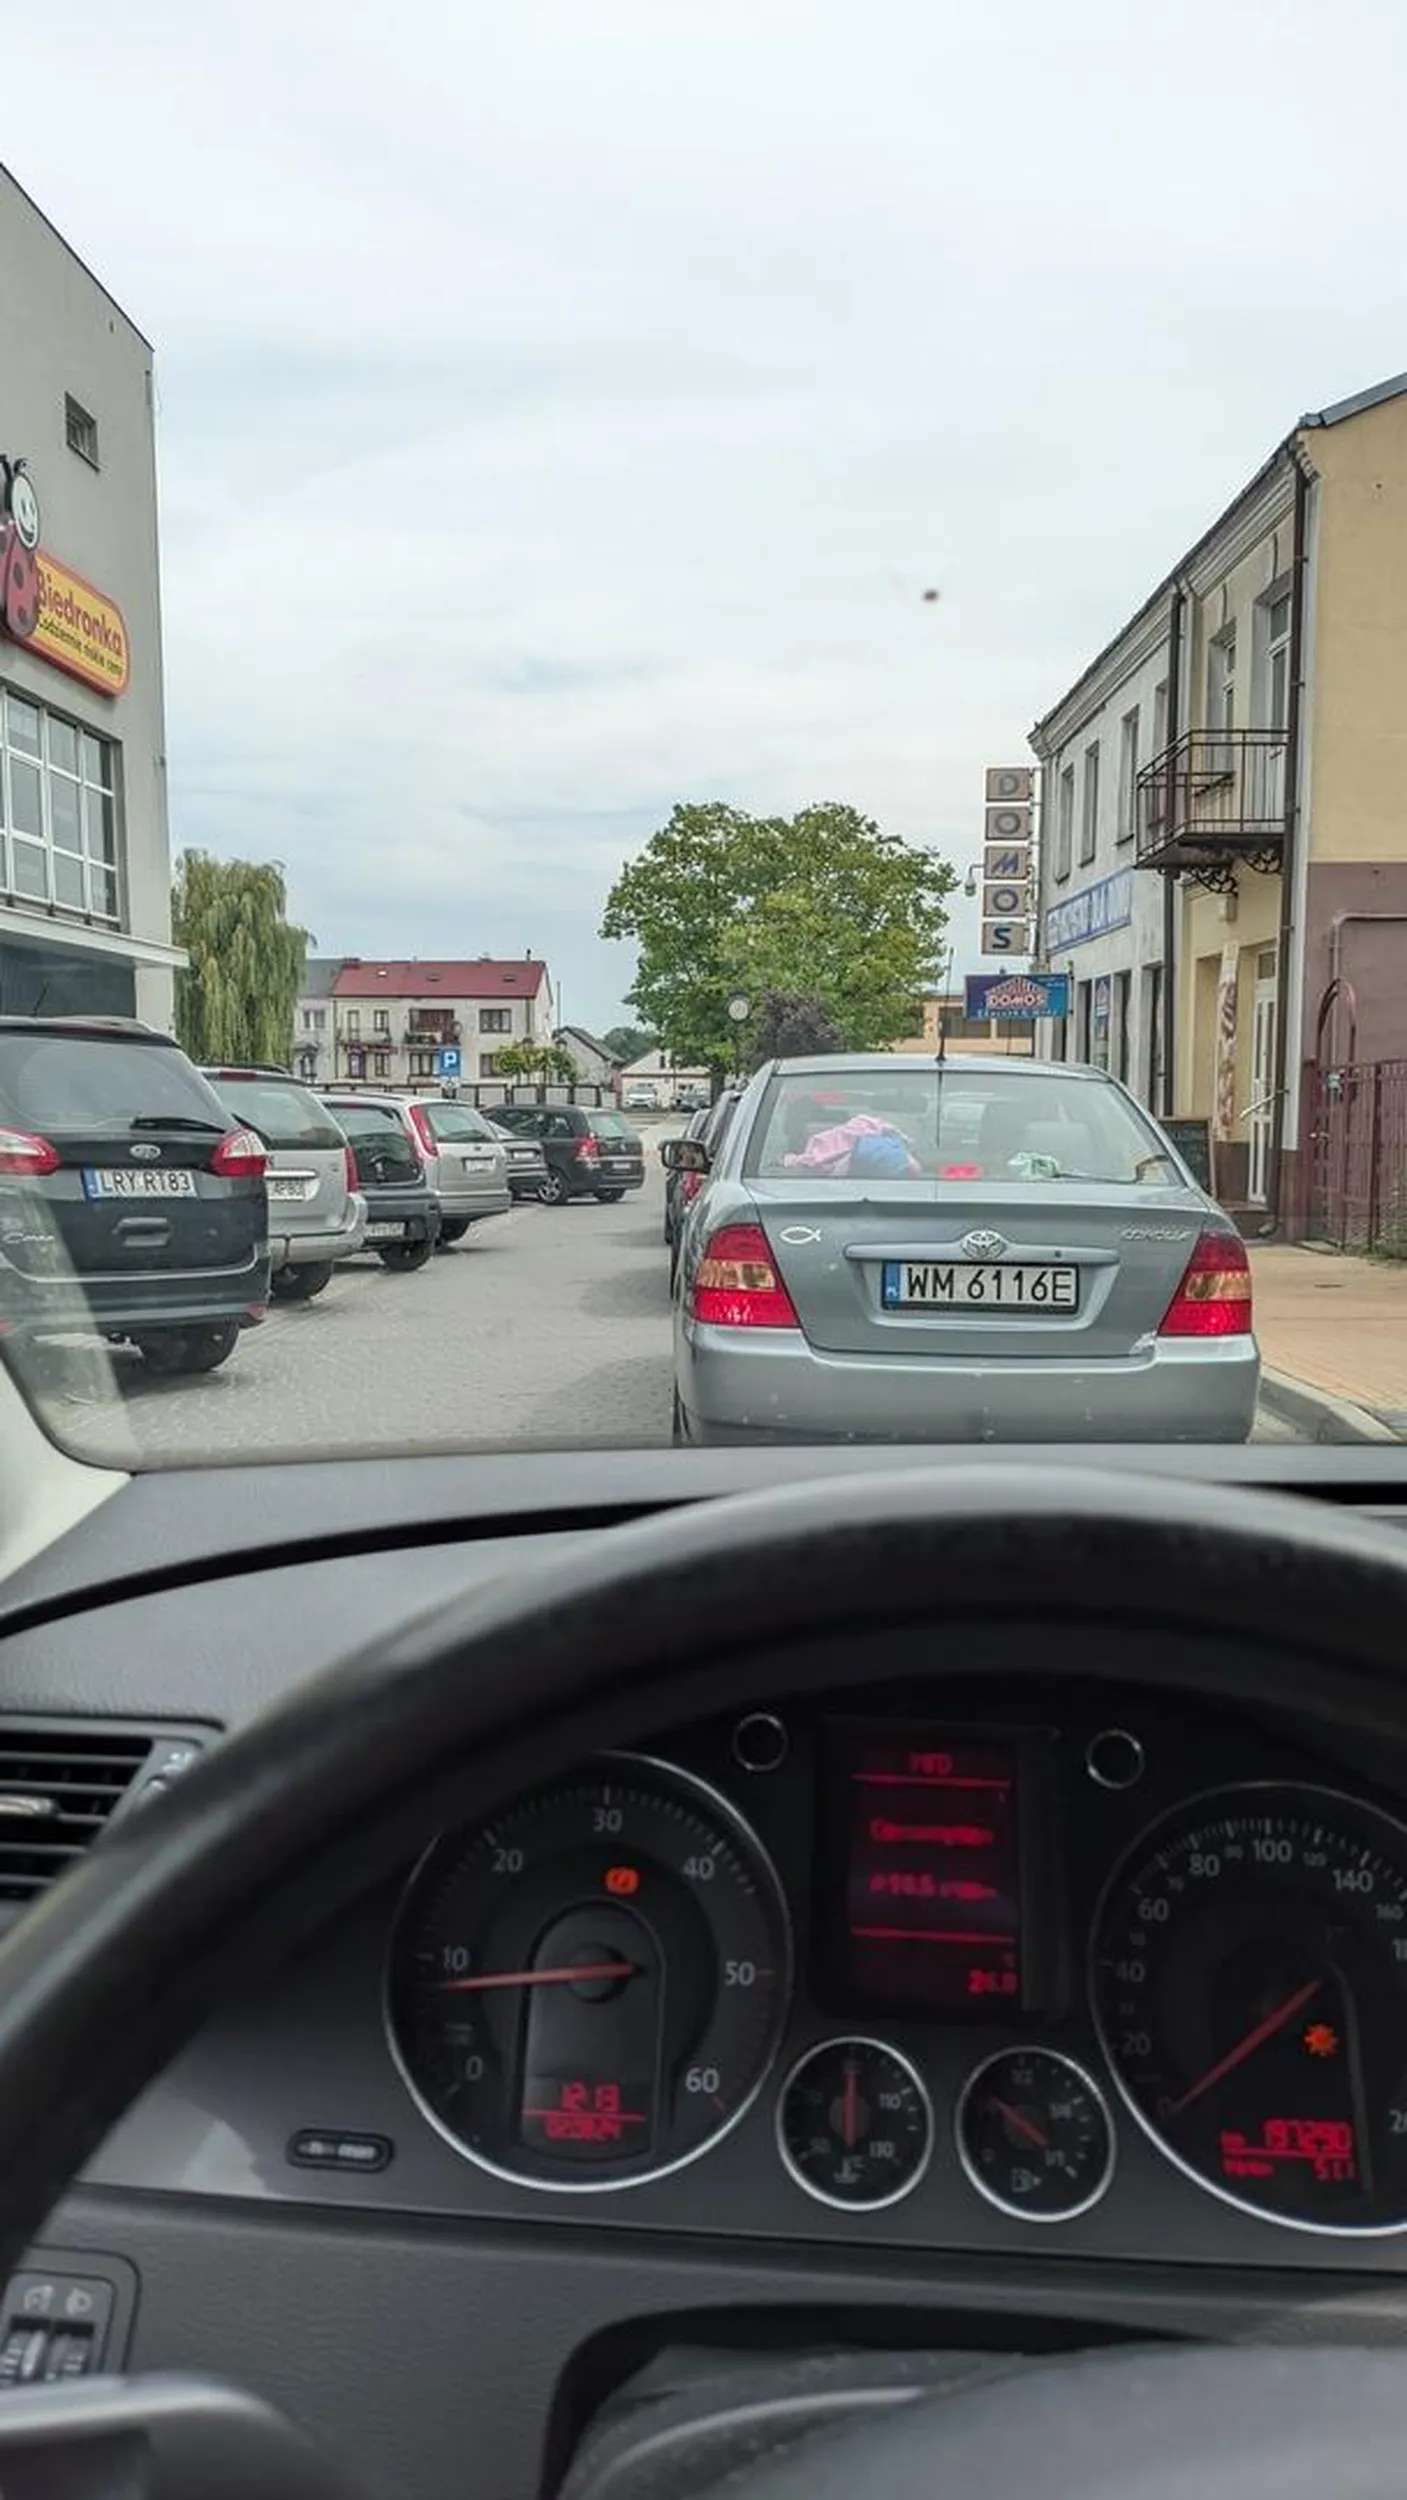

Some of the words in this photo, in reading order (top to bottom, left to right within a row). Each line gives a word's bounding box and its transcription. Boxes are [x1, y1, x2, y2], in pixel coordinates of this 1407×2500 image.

[37, 568, 122, 657] Biedronka
[986, 993, 1045, 1007] DOMOS
[444, 1052, 457, 1068] P
[102, 1170, 143, 1192] LRY
[145, 1170, 190, 1193] RT83
[907, 1267, 955, 1300] WM
[967, 1269, 1072, 1303] 6116E
[593, 1809, 623, 1833] 30
[492, 1848, 525, 1874] 20
[1253, 1840, 1292, 1863] 100
[684, 1857, 715, 1881] 40
[1188, 1854, 1220, 1877] 80
[1332, 1869, 1374, 1893] 140
[1137, 1898, 1169, 1922] 60
[443, 1946, 470, 1971] 10
[725, 1961, 756, 1987] 50
[1115, 1961, 1145, 1983] 40
[1122, 2033, 1152, 2056] 20
[466, 2055, 483, 2081] 0
[685, 2067, 720, 2094] 60
